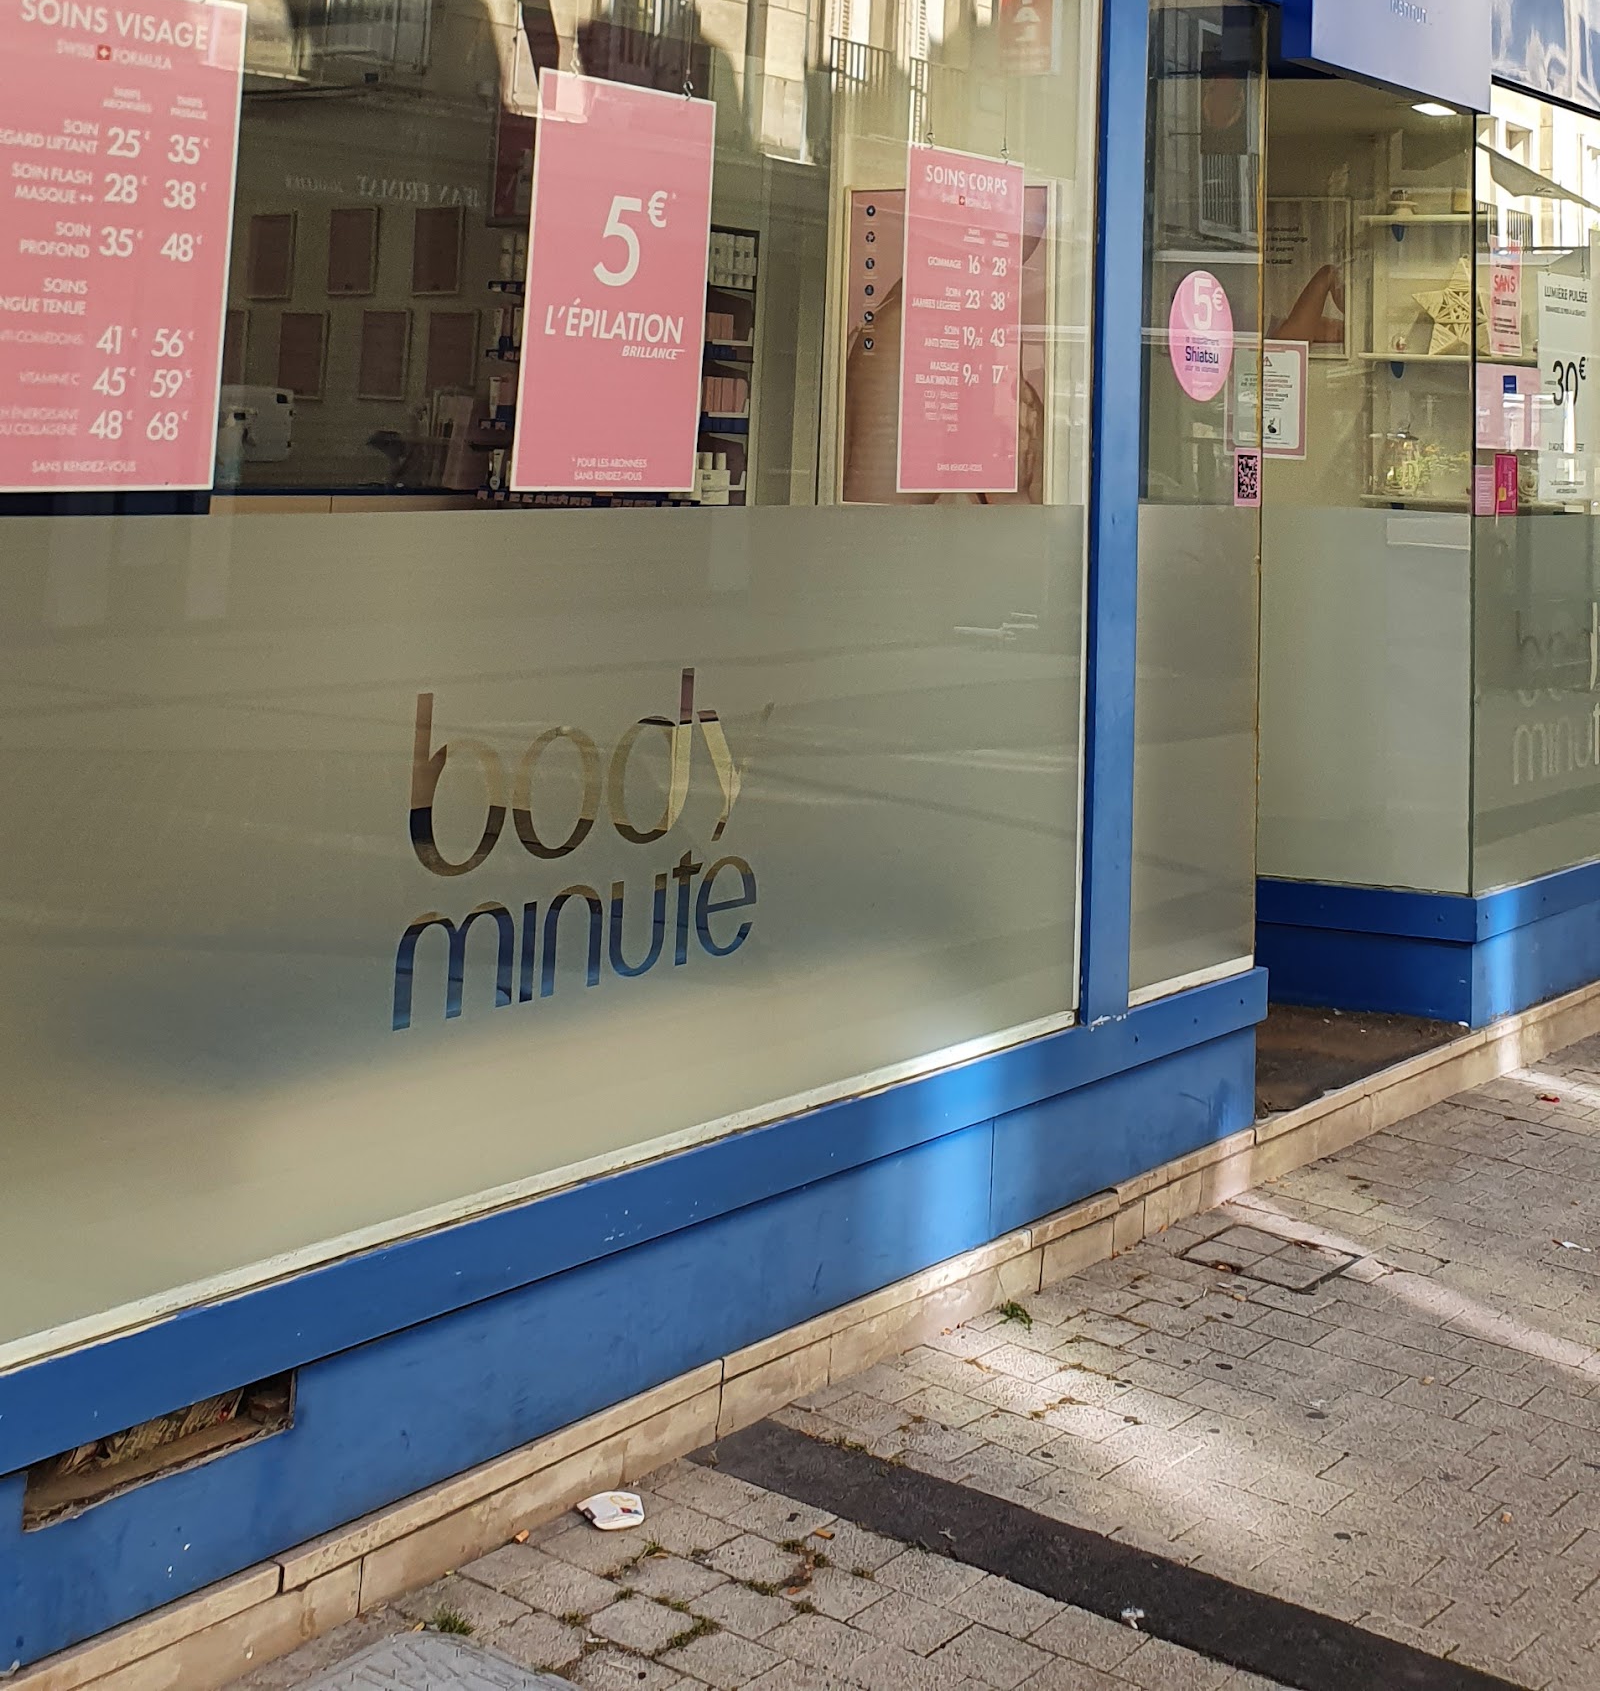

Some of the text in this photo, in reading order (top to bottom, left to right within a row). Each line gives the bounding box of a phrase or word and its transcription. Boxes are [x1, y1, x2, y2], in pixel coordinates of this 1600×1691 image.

[115, 11, 209, 51] VISAGE
[113, 49, 172, 70] FORMULA
[63, 119, 99, 136] SOIN
[46, 135, 98, 154] LIFTANT
[11, 161, 93, 185] SOIN FLASH
[925, 164, 1008, 196] SOINS CORPS
[15, 184, 77, 204] MASQUE
[55, 221, 91, 238] SOIN
[20, 239, 90, 258] PROFOND
[43, 277, 88, 295] SOINS
[1494, 274, 1516, 293] SANS
[42, 298, 87, 315] TENUE
[544, 298, 685, 345] L'ÉPILATION
[622, 344, 685, 361] BRILLANCE
[1185, 345, 1219, 364] Shiatsu
[31, 460, 61, 474] SANS
[410, 667, 745, 877] body
[392, 850, 757, 1032] minute
